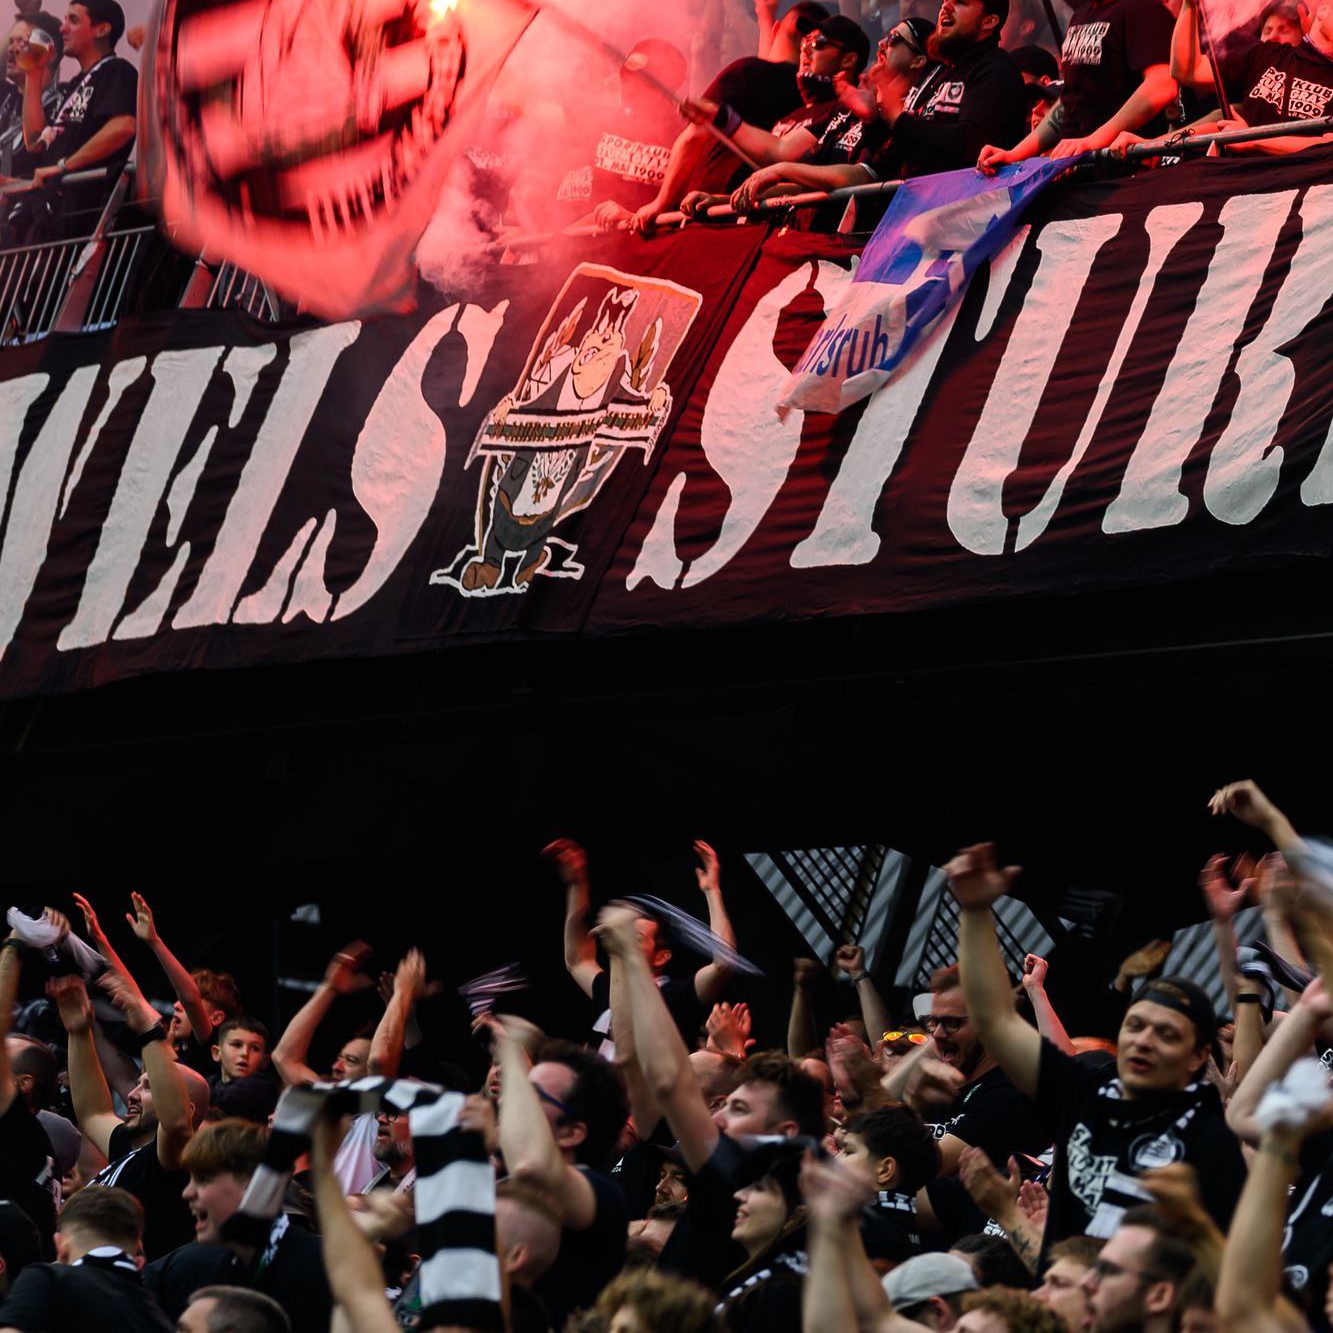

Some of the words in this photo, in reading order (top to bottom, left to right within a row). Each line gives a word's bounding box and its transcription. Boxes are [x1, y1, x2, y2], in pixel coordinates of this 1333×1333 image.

[1290, 100, 1321, 117] 1909
[635, 165, 665, 180] 1909
[800, 313, 890, 379] rlsruh
